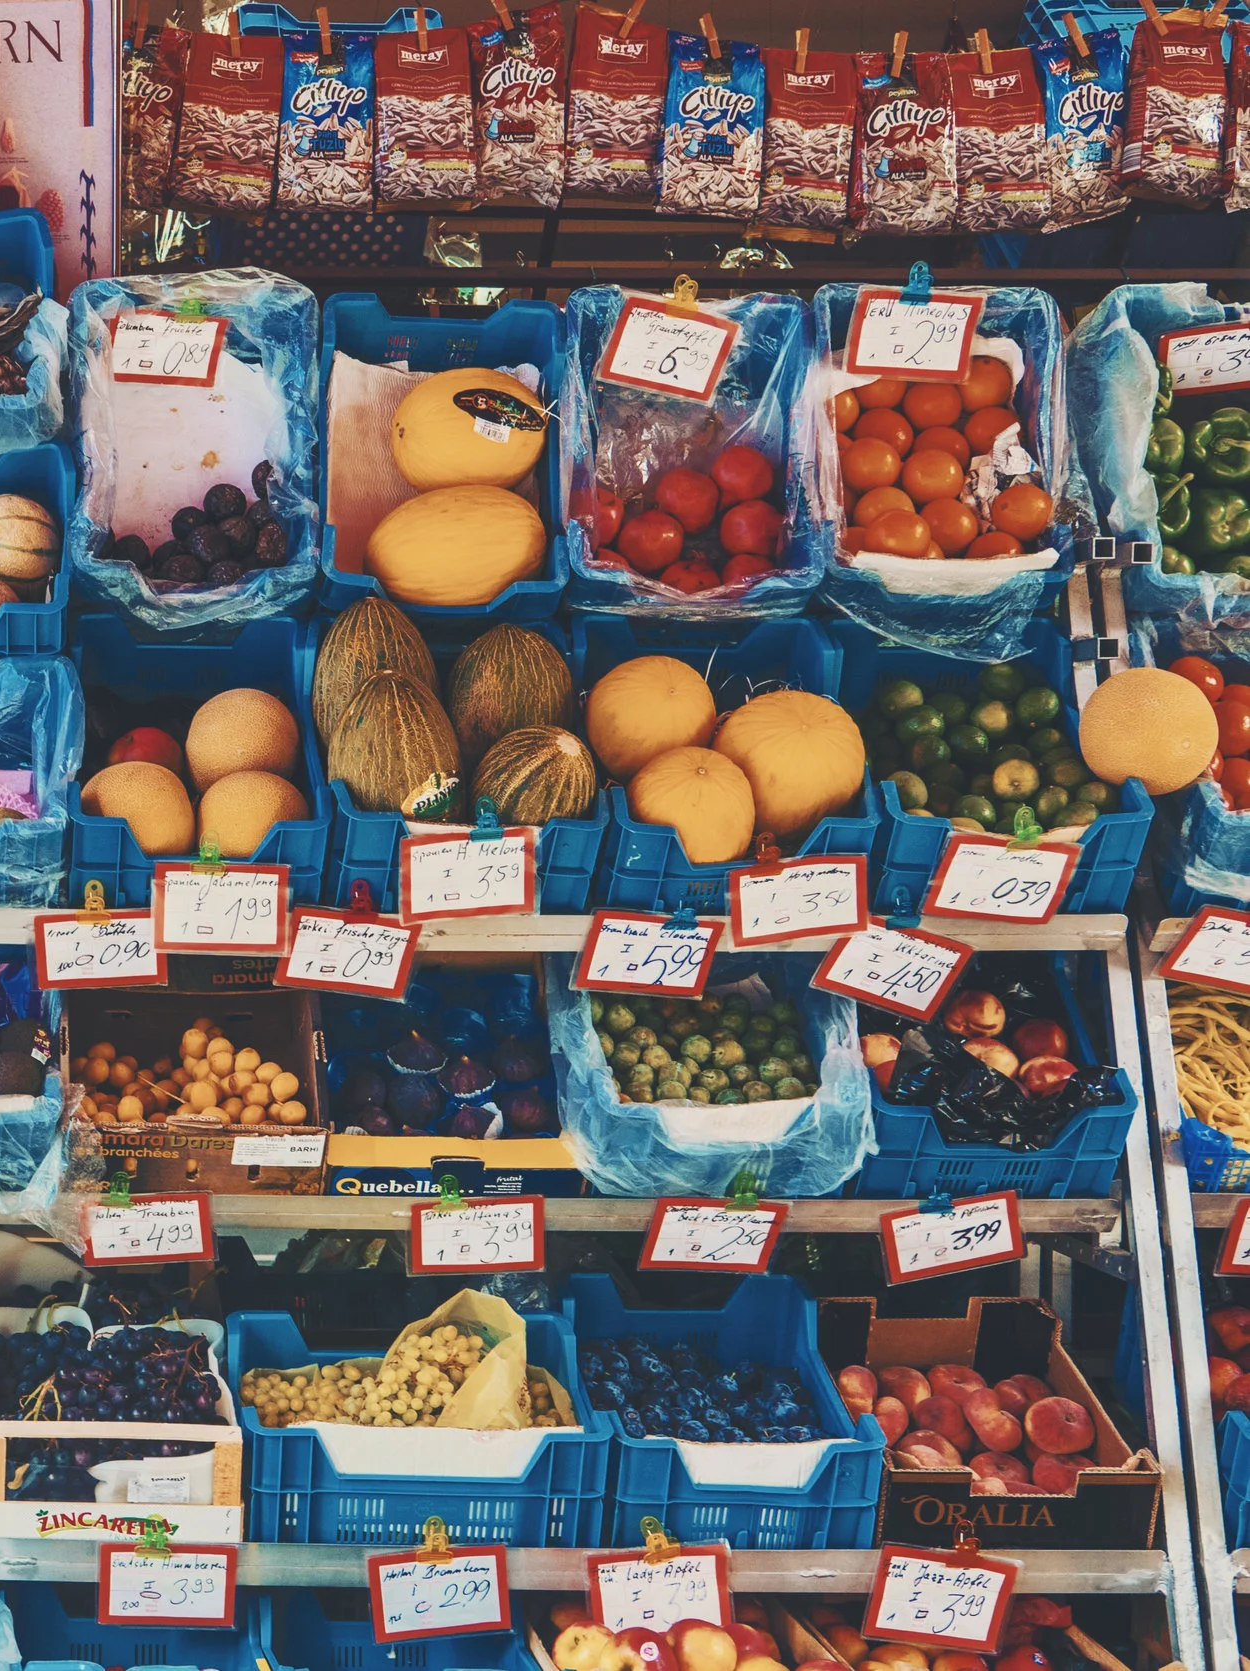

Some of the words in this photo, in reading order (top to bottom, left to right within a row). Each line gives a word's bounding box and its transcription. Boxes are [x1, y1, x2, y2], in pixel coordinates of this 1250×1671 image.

[401, 49, 444, 62] meray
[1163, 44, 1207, 57] meray
[214, 57, 261, 73] meray
[787, 71, 832, 86] meray
[972, 74, 1018, 90] meray
[901, 1493, 1056, 1528] ORALIA
